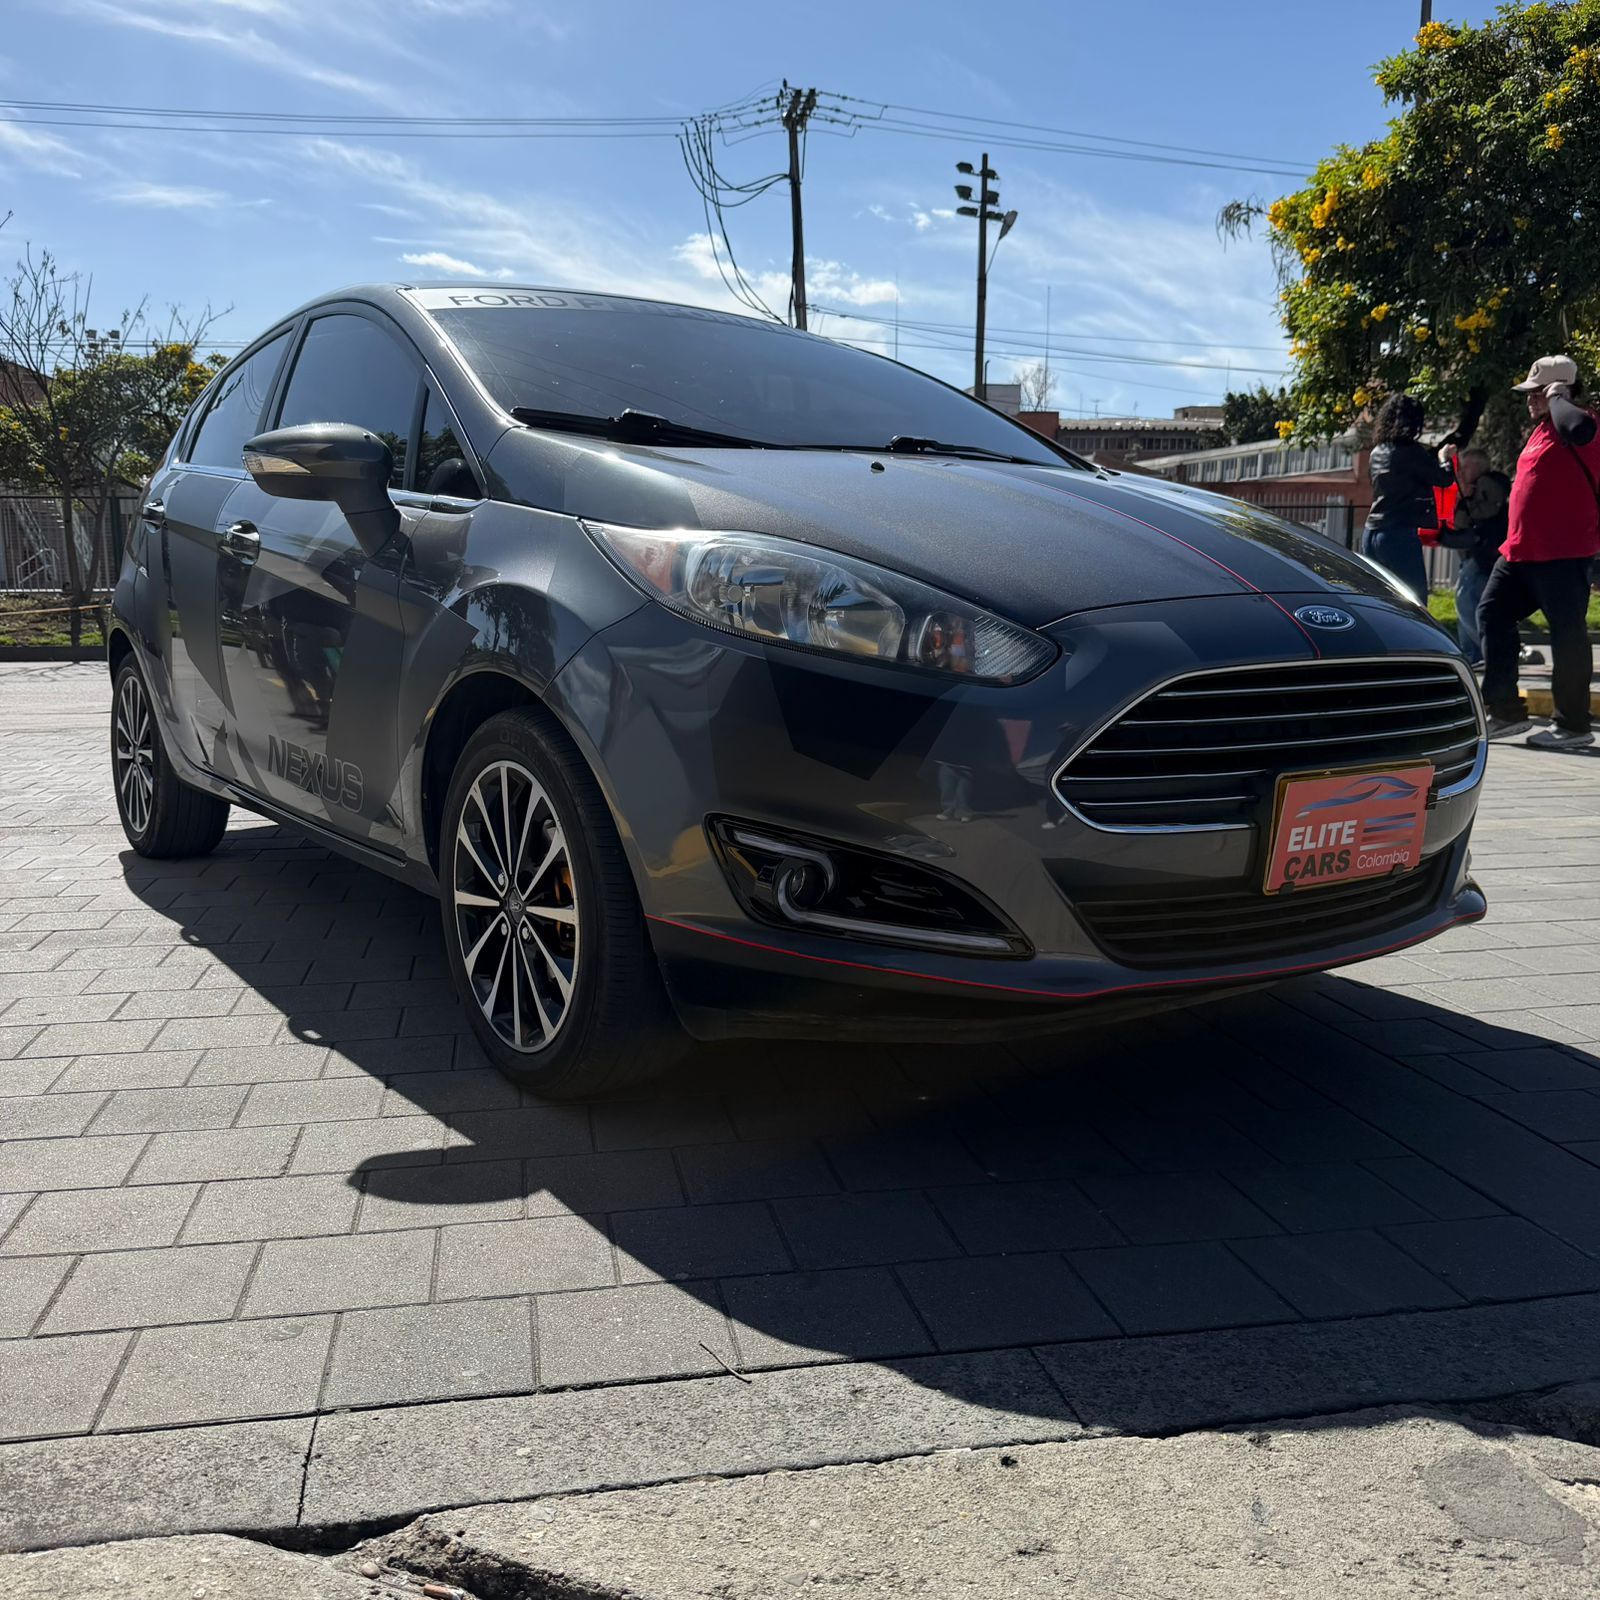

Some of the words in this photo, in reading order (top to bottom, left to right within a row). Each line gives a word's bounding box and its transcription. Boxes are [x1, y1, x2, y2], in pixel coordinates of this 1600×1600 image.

[448, 295, 569, 307] FORD
[1309, 610, 1343, 624] Ford
[268, 734, 364, 814] NEXUS
[1287, 819, 1359, 852] ELITE
[1283, 849, 1351, 880] CARS
[1356, 848, 1410, 869] Colombia
